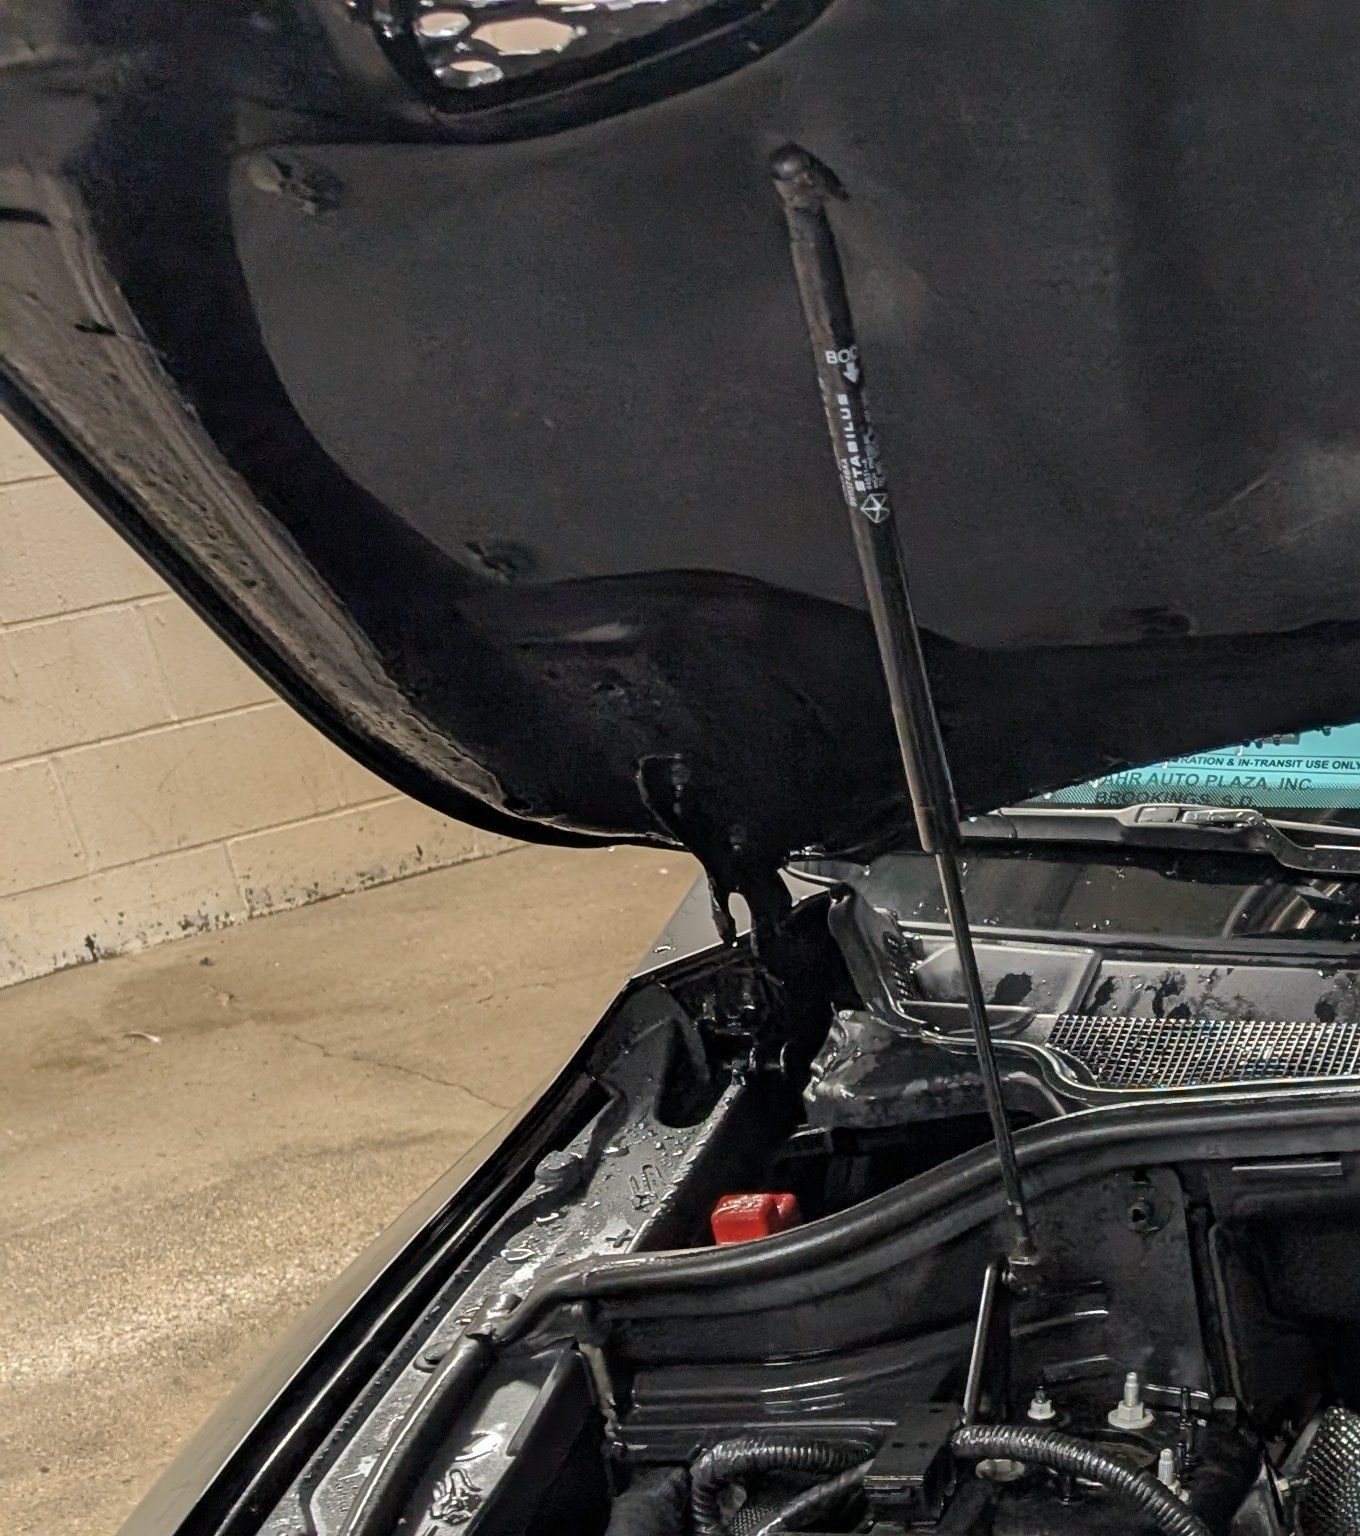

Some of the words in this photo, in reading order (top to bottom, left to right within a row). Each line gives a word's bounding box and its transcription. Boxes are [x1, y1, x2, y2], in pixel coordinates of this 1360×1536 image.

[836, 393, 867, 492] STABILUS
[1226, 758, 1235, 767] &
[1238, 757, 1303, 769] IN-TRANSIT
[1305, 759, 1329, 770] USE
[1146, 772, 1200, 788] AUTO
